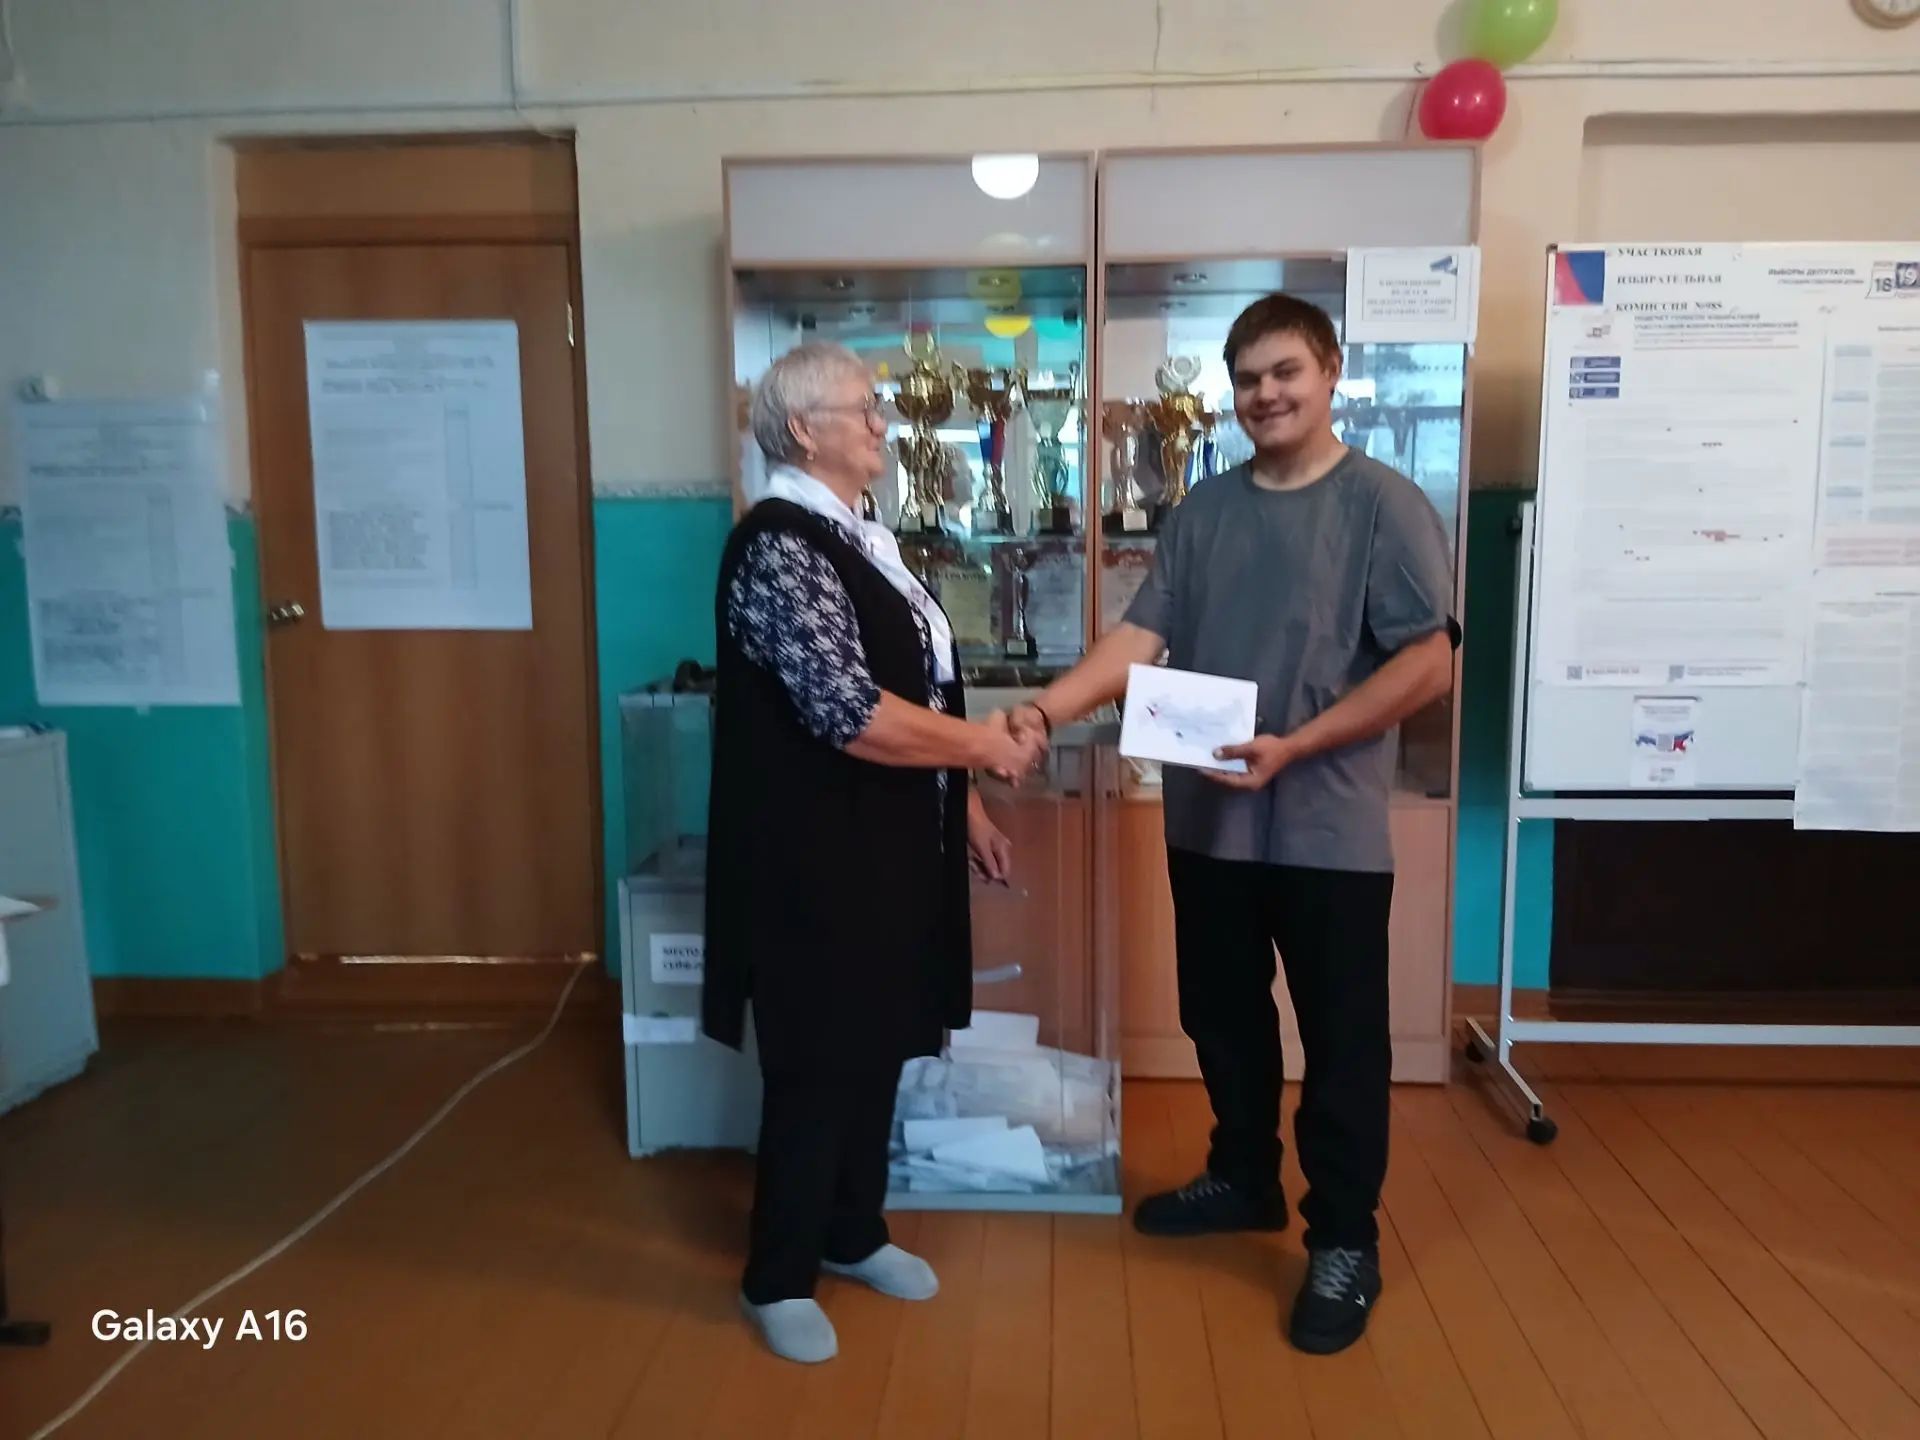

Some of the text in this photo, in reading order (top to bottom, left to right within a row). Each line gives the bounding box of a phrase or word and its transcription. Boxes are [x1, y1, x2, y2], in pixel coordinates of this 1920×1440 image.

[1617, 248, 1703, 257] УЧАСТКОВАЯ
[1617, 275, 1722, 285] ИЗБИРАТЕЛЬНАЯ
[1874, 278, 1892, 293] 18
[1616, 302, 1688, 312] КОМИССИЯ
